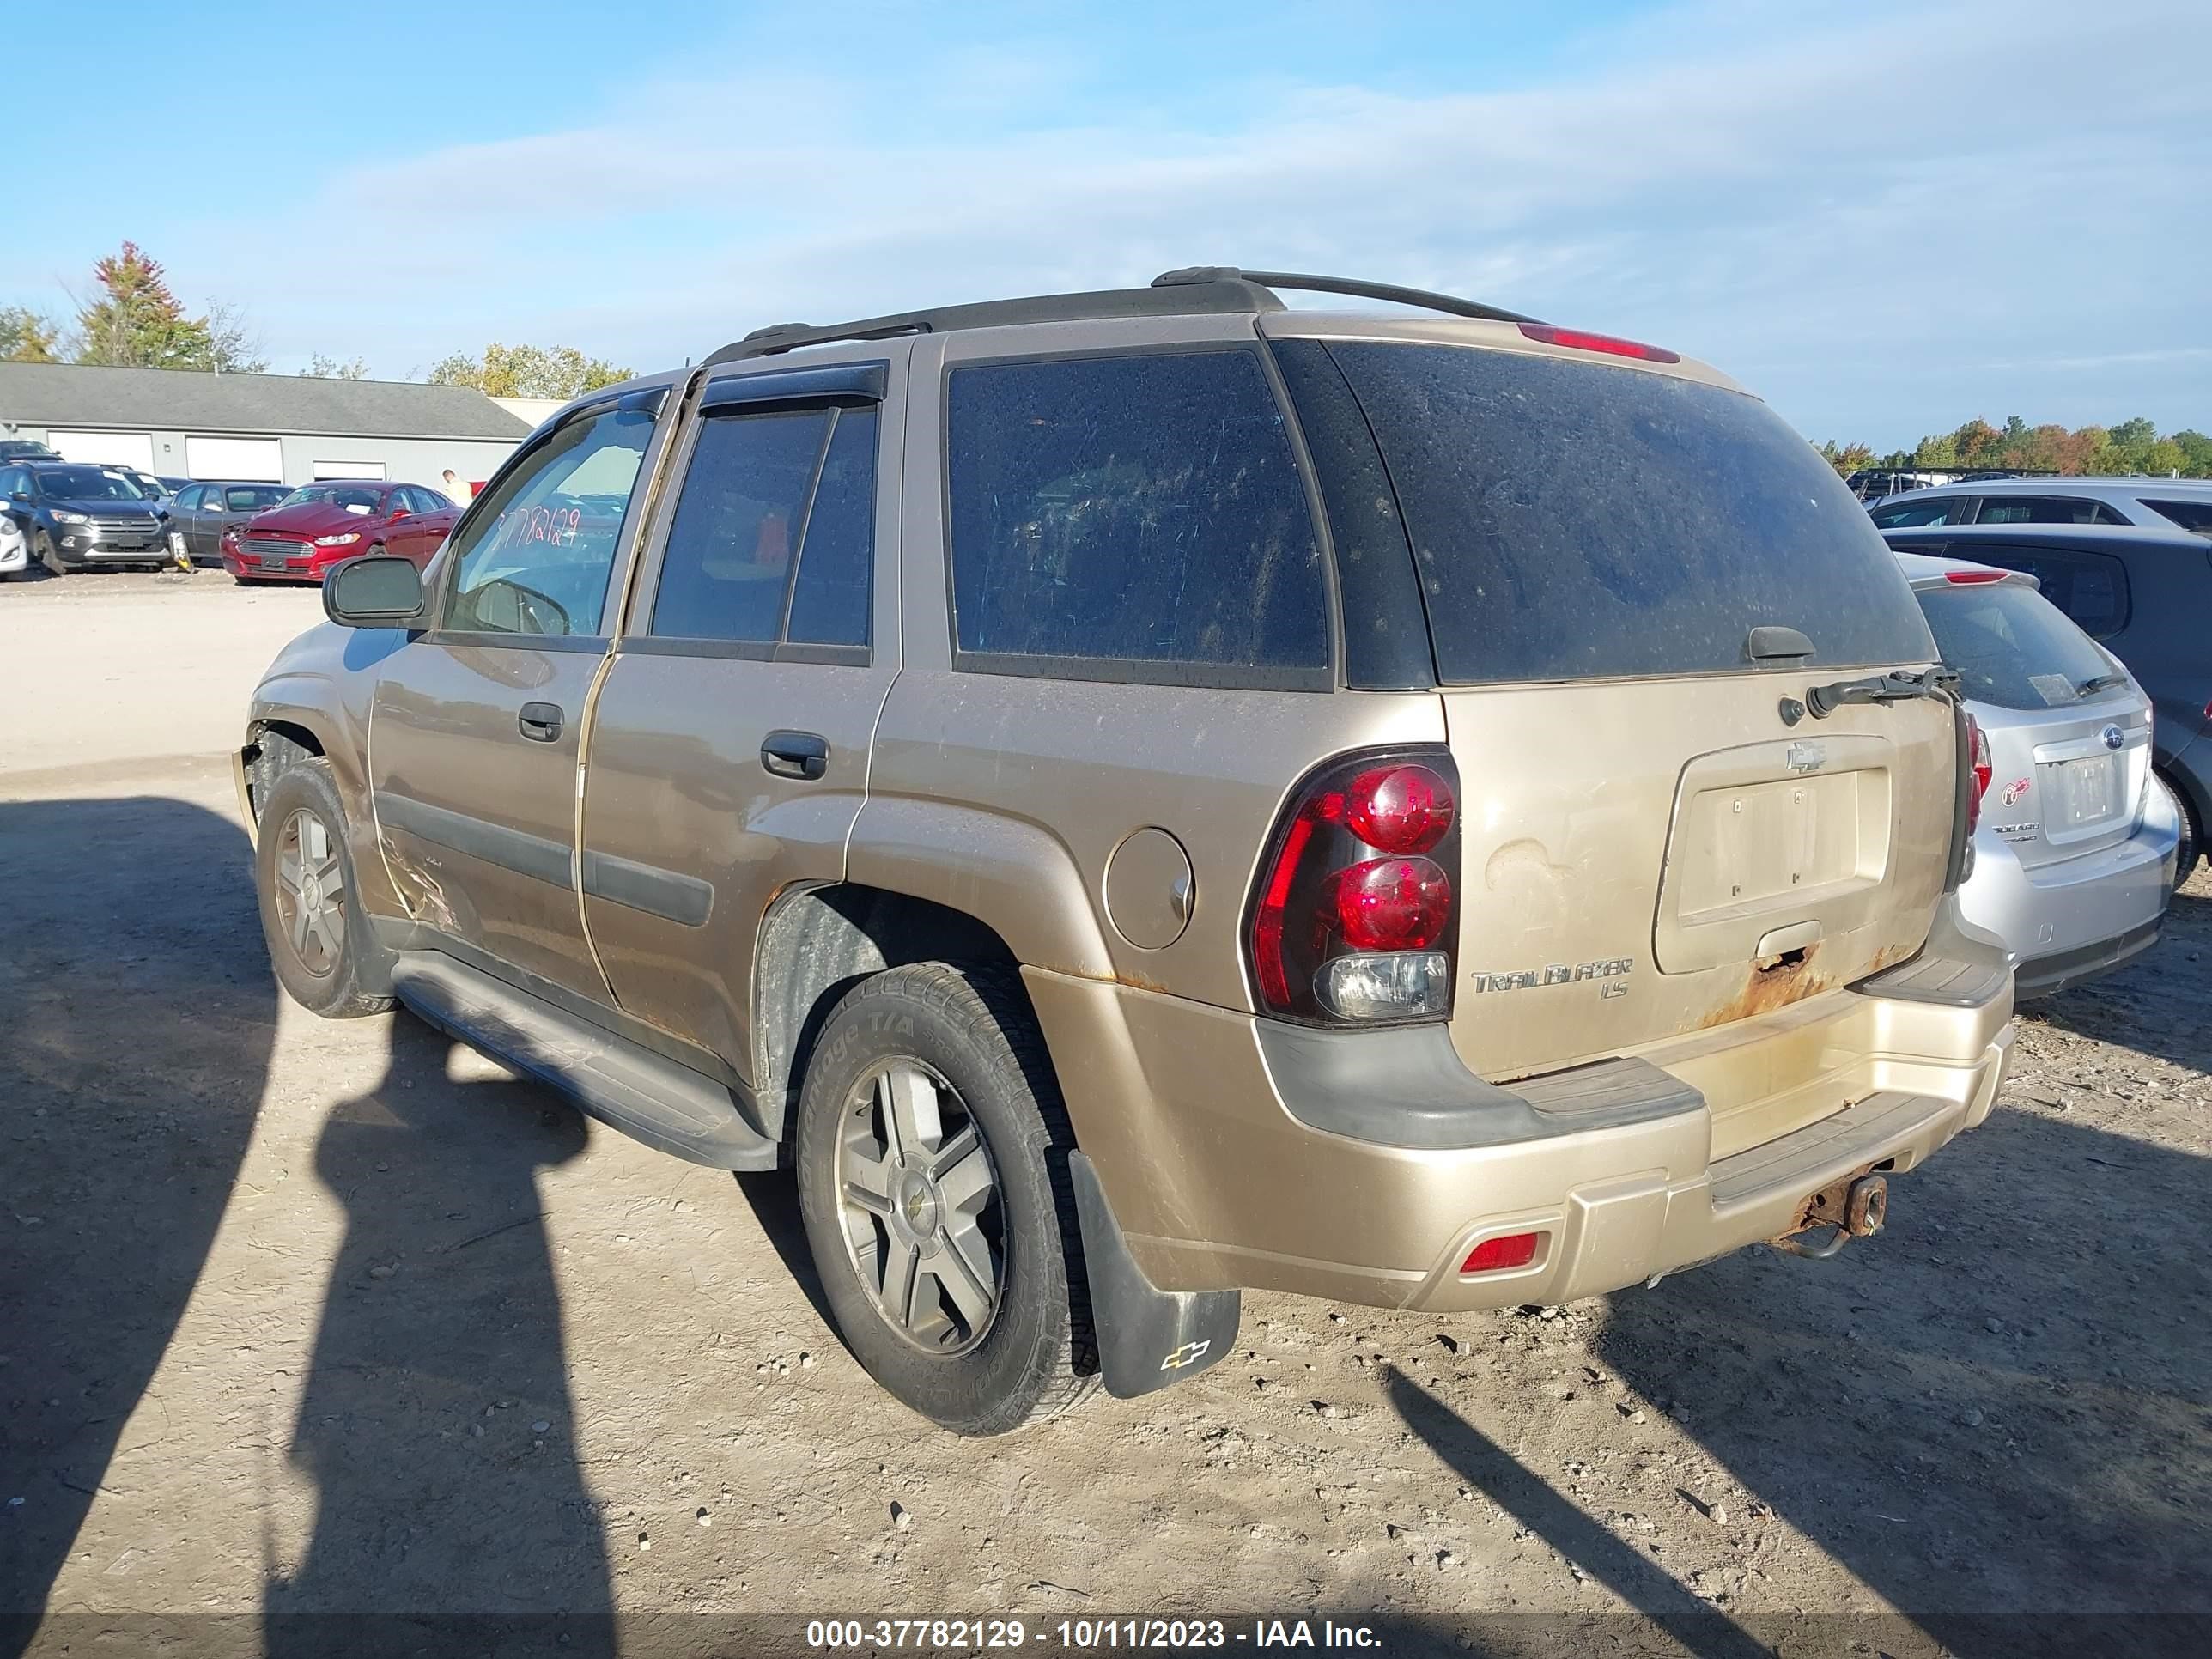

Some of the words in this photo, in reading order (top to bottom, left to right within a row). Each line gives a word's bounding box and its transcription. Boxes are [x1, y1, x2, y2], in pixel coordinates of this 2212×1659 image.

[492, 505, 581, 551] 37782129
[1991, 822, 2040, 834] SUBARU
[1600, 981, 1629, 1000] LS
[867, 1011, 914, 1037] T/A
